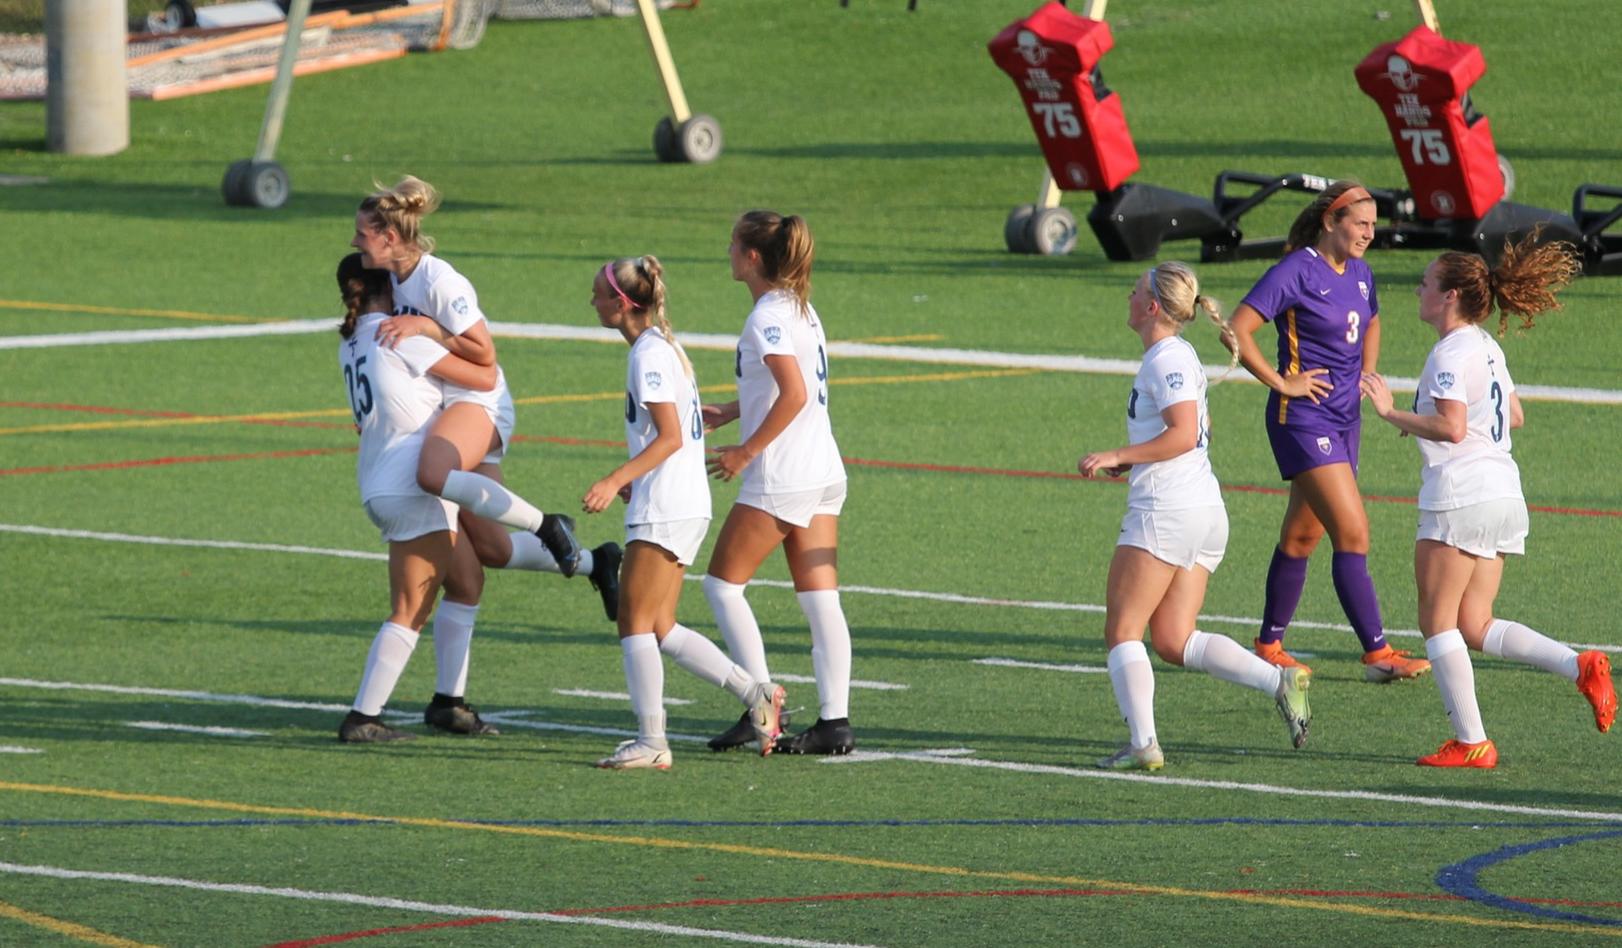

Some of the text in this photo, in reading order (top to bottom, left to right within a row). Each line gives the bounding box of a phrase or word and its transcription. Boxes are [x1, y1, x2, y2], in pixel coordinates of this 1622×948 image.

[1032, 102, 1082, 138] 75
[1400, 129, 1451, 165] 75
[1346, 310, 1360, 344] 3
[344, 354, 373, 423] 25
[816, 344, 826, 406] 9
[1490, 381, 1504, 443] 3
